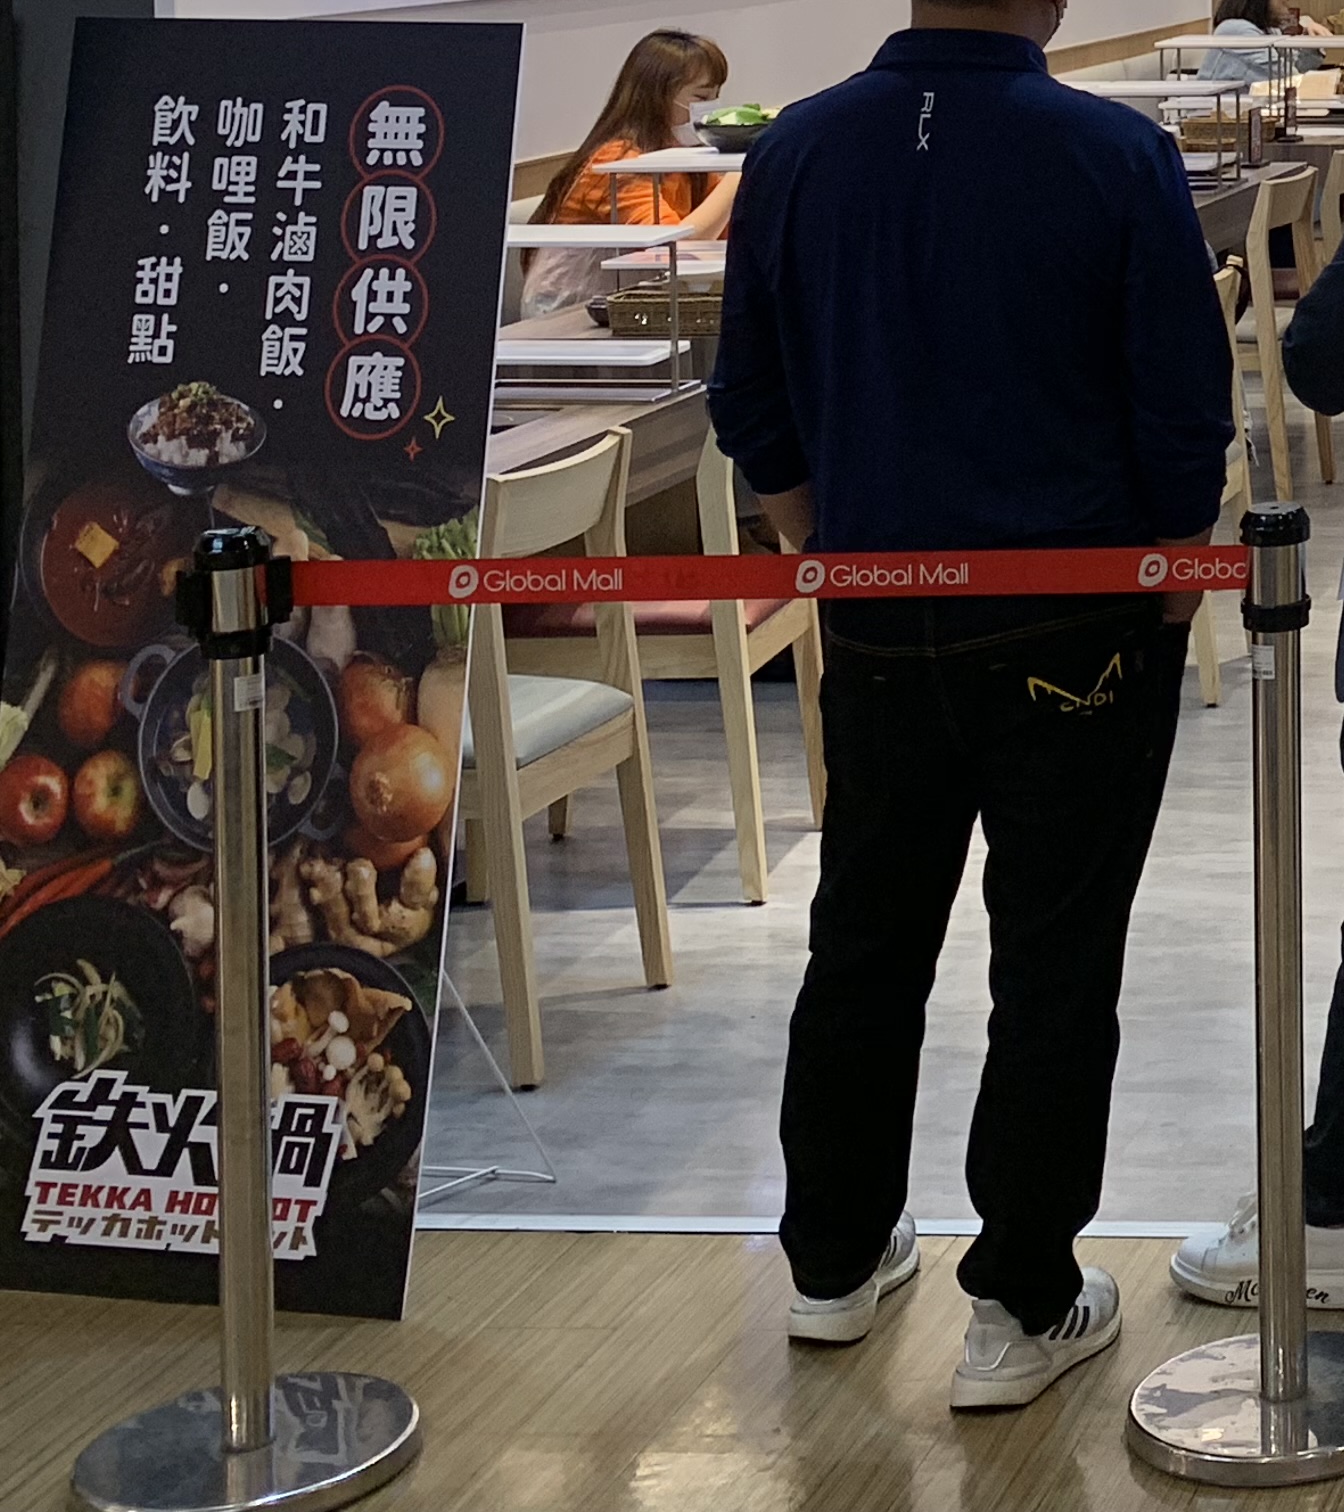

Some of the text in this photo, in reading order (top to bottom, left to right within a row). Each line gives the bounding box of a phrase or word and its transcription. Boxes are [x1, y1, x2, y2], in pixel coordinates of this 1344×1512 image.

[916, 91, 935, 151] RLX
[340, 100, 427, 421] 無限供應
[483, 568, 623, 592] Global Mall
[830, 562, 969, 587] Global Mall
[35, 1181, 318, 1223] TEKKA HOOT
